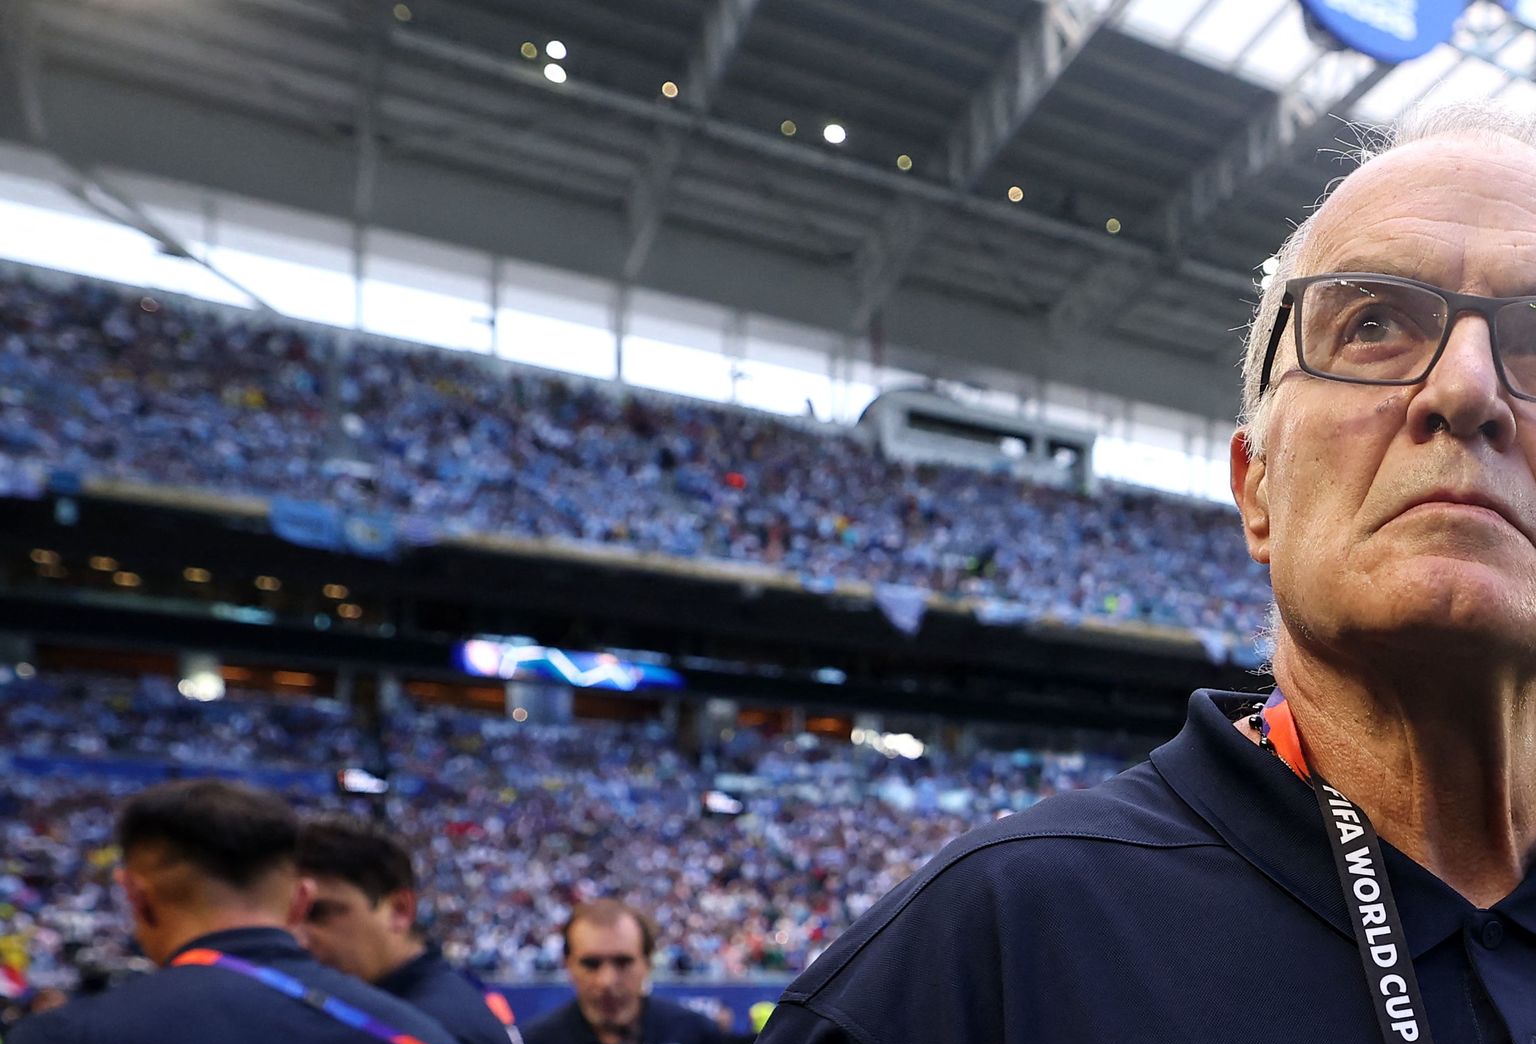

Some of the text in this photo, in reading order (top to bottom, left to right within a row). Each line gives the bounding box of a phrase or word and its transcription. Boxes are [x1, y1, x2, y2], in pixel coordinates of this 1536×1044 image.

[1322, 784, 1365, 844] FIFA
[1345, 846, 1398, 968] WORLD
[1379, 974, 1419, 1042] CUP
